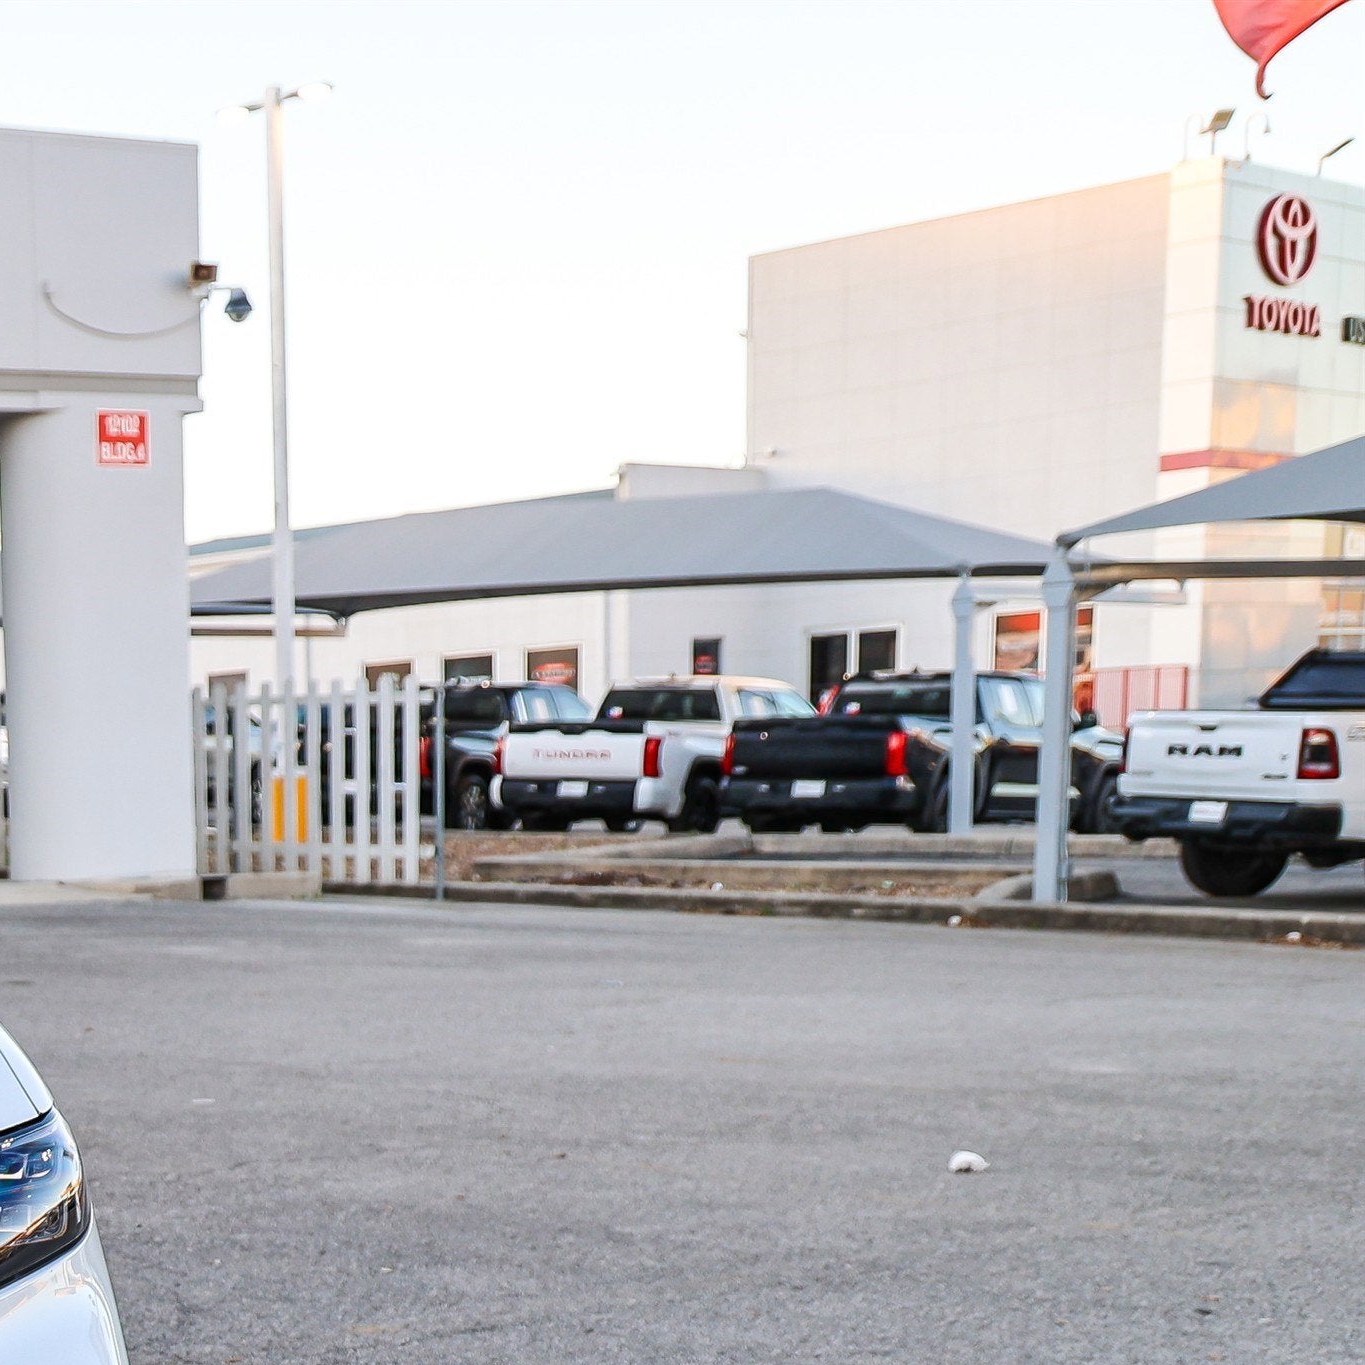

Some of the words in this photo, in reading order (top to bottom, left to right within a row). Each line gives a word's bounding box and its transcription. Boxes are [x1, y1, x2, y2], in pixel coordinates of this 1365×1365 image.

[1243, 295, 1320, 337] TOYOTA
[533, 748, 611, 759] TUNDRA
[1168, 745, 1242, 757] RAM
